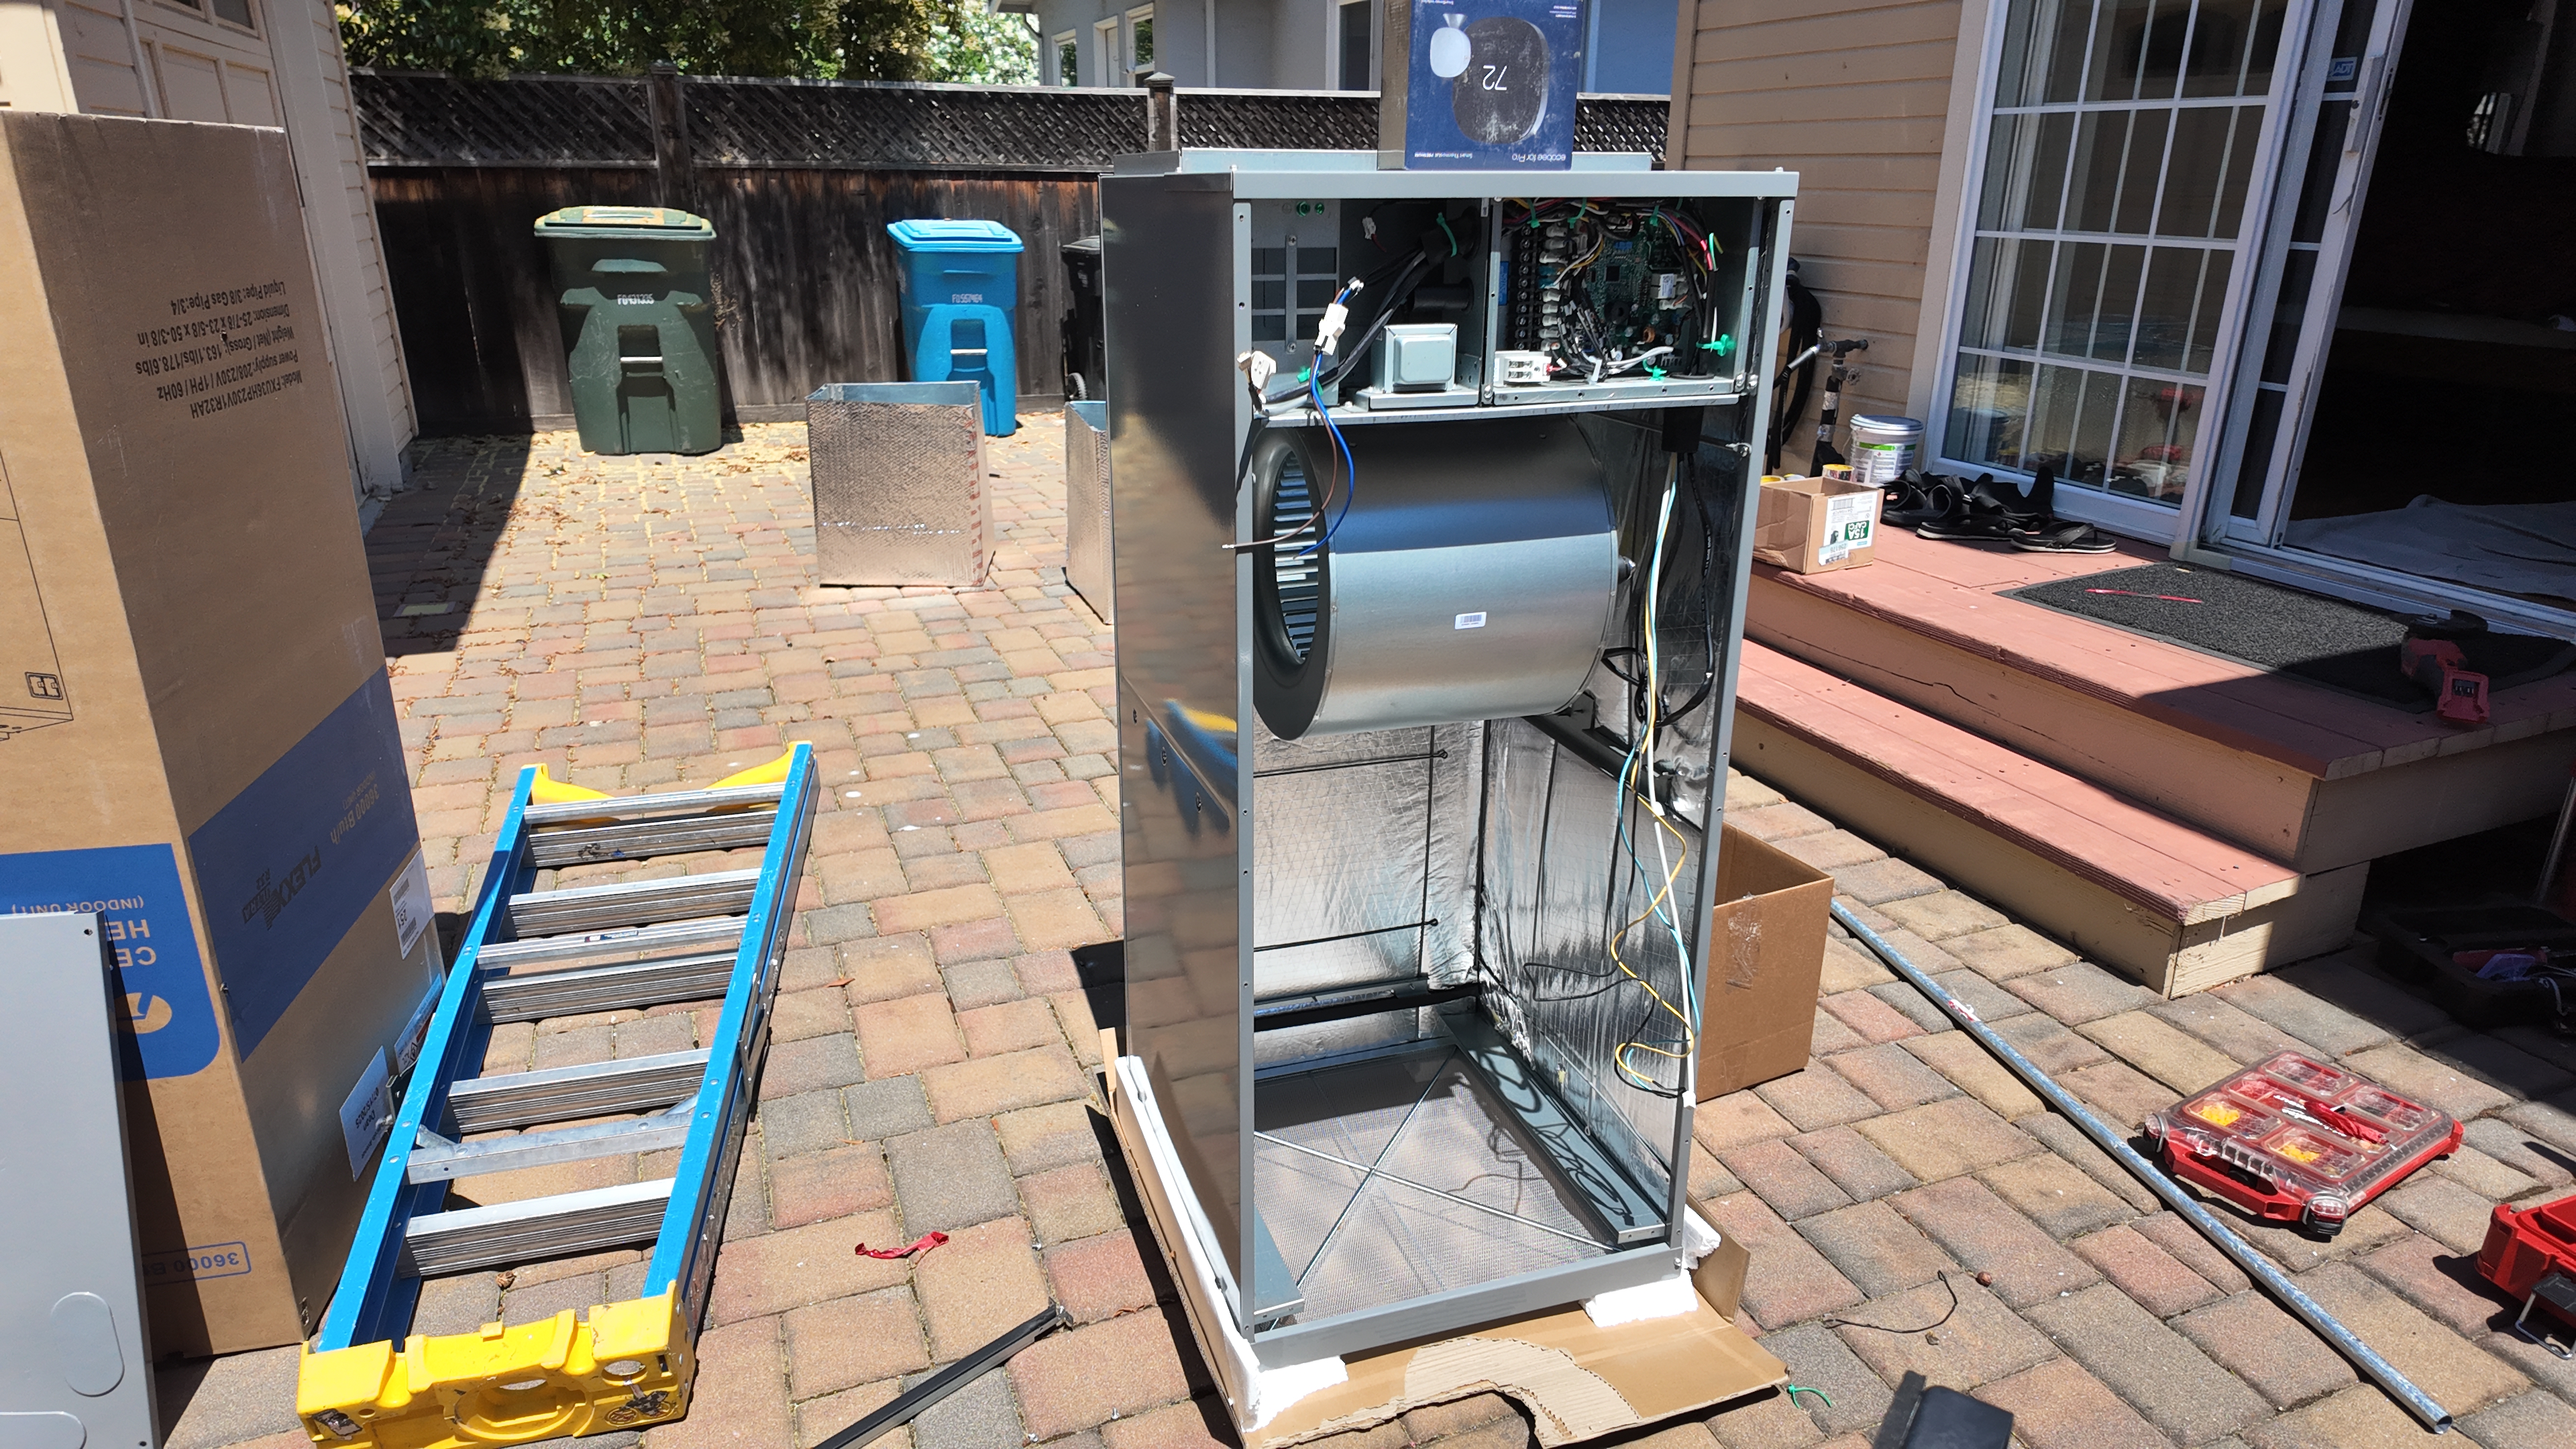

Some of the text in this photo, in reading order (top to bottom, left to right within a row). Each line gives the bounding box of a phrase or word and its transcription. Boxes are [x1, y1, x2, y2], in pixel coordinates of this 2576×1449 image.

[1483, 65, 1507, 91] 72
[2330, 63, 2353, 75] ADT
[1511, 153, 1566, 163] ecobee for Pro
[229, 290, 241, 303] 3/8
[242, 284, 263, 301] Pipe:
[264, 279, 286, 298] Liquid
[211, 291, 228, 307] Gas
[138, 303, 290, 348] Dimension: 25-7/8 x 23-5/8 x 50-3/8 in
[272, 325, 294, 343] Weight
[256, 328, 272, 348] (Net
[135, 343, 223, 376] 163.1lbs/178.6lbs
[278, 349, 299, 366] Power
[156, 382, 183, 402] 60Hz
[189, 374, 209, 394] 1PH
[190, 370, 303, 419] Model: FXU36HP230V1R32AH
[1847, 521, 1867, 531] CAFCI
[1848, 527, 1866, 540] 15A
[330, 784, 380, 845] 36000 Btu/h
[65, 895, 144, 912] (INDOOR
[243, 888, 271, 921] ULTRA
[396, 909, 408, 930] 251
[362, 1109, 376, 1132] Dean
[173, 1252, 239, 1273] 36000
